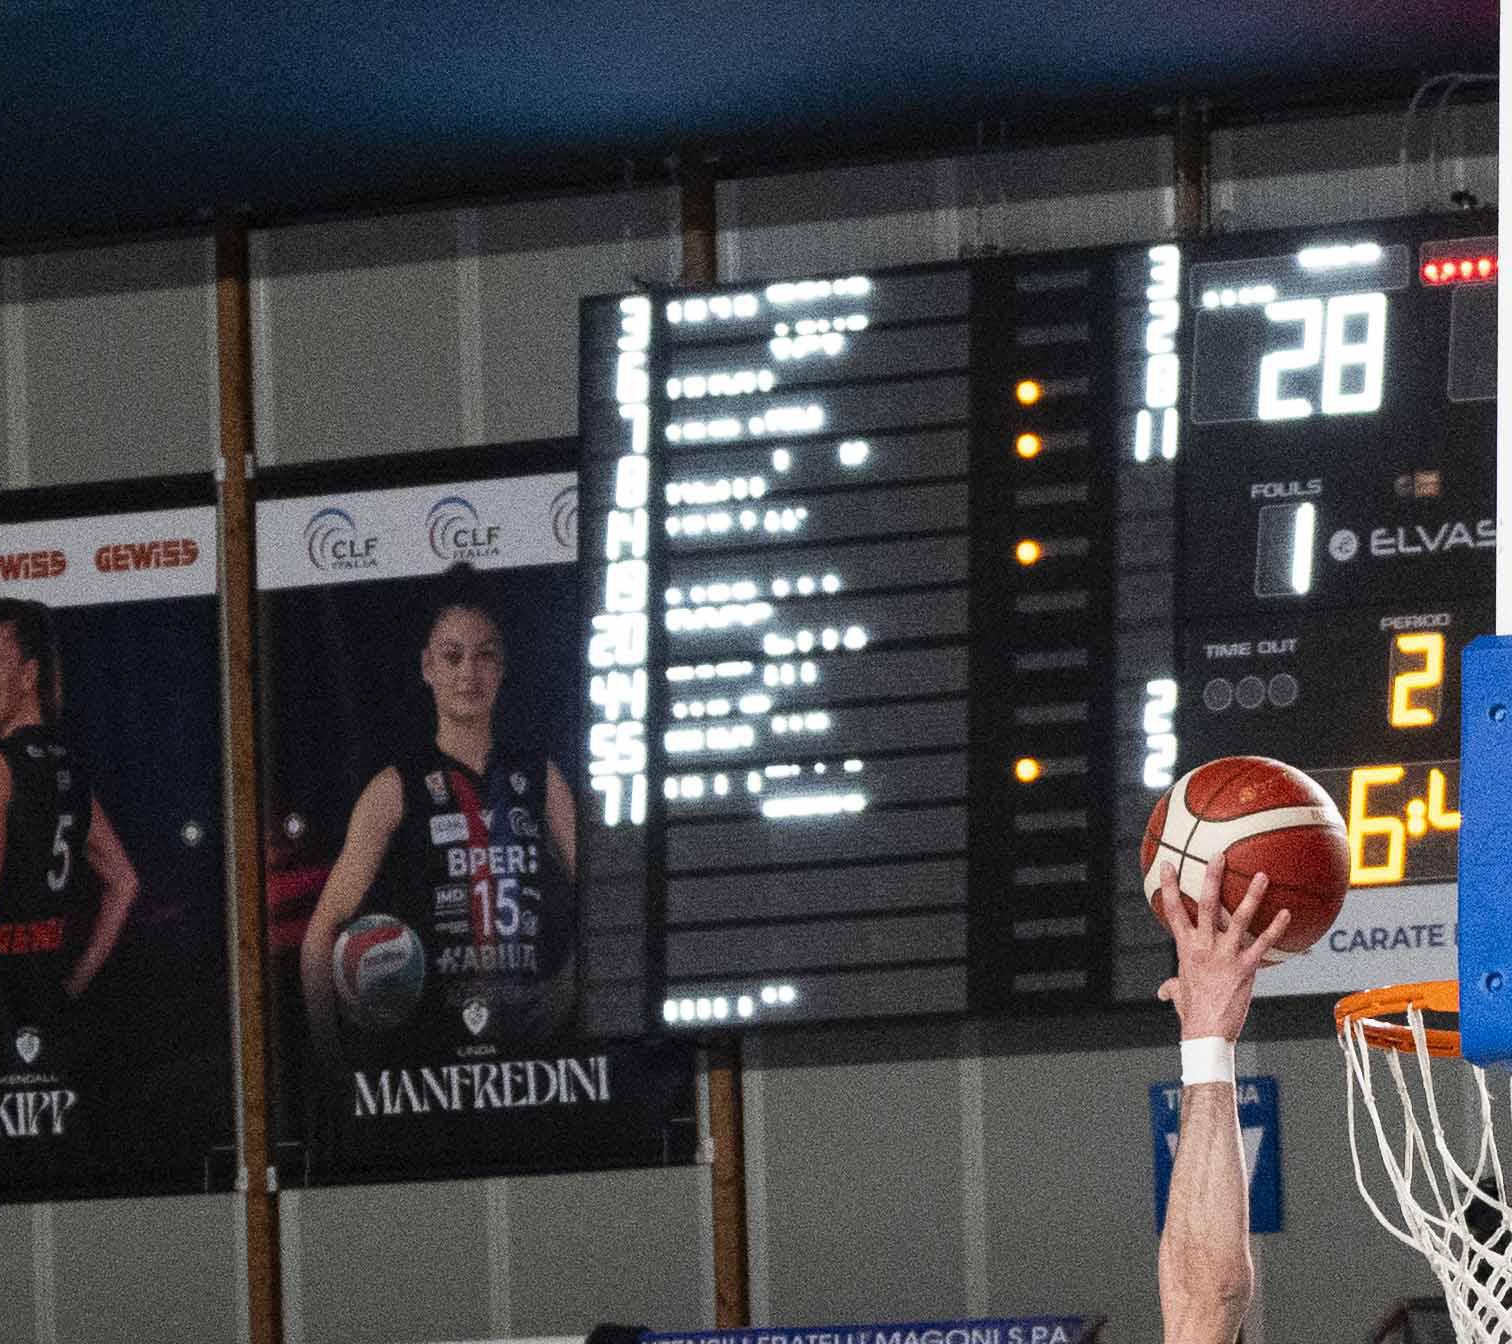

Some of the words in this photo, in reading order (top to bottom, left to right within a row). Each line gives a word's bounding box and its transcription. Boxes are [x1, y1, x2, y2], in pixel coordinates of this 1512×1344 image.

[1259, 291, 1387, 421] 28
[1250, 478, 1322, 499] FOULS
[329, 537, 379, 560] CLF
[451, 524, 503, 550] CLF
[1290, 501, 1316, 595] 1
[1380, 612, 1452, 631] PERIOD
[1202, 641, 1255, 661] TIME
[1261, 637, 1299, 658] OUT
[1390, 632, 1446, 729] 2
[472, 878, 520, 937] 15
[1329, 924, 1448, 955] CARATE
[353, 1055, 611, 1118] MANFREDINI
